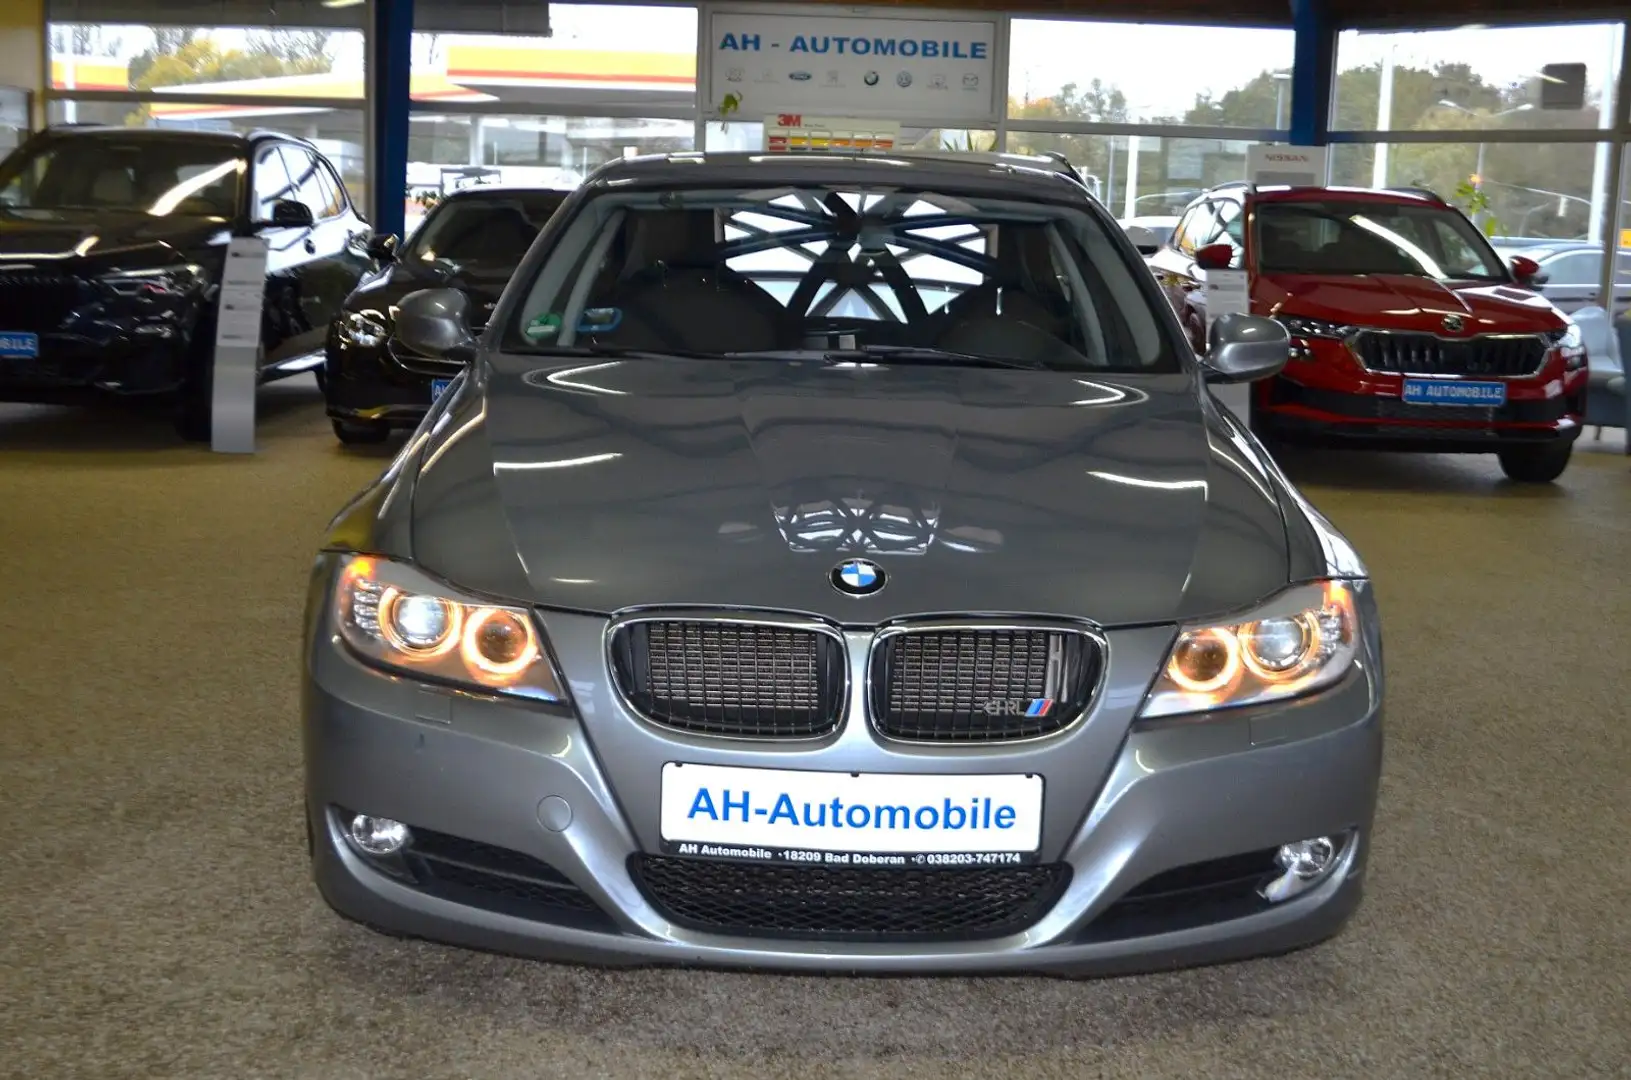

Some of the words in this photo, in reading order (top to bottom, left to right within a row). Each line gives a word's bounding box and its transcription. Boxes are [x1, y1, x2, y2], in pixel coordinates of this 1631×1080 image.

[719, 33, 760, 51] AH
[789, 36, 987, 59] AUTOMOBILE
[777, 113, 802, 127] 3M
[1405, 384, 1421, 396] AH
[1426, 385, 1503, 398] AUTOMOBILE
[687, 787, 1017, 830] AH-Automobile
[678, 843, 698, 854] AH
[701, 844, 773, 859] Automobile
[824, 852, 849, 864] Bad
[852, 853, 906, 865] Doberan
